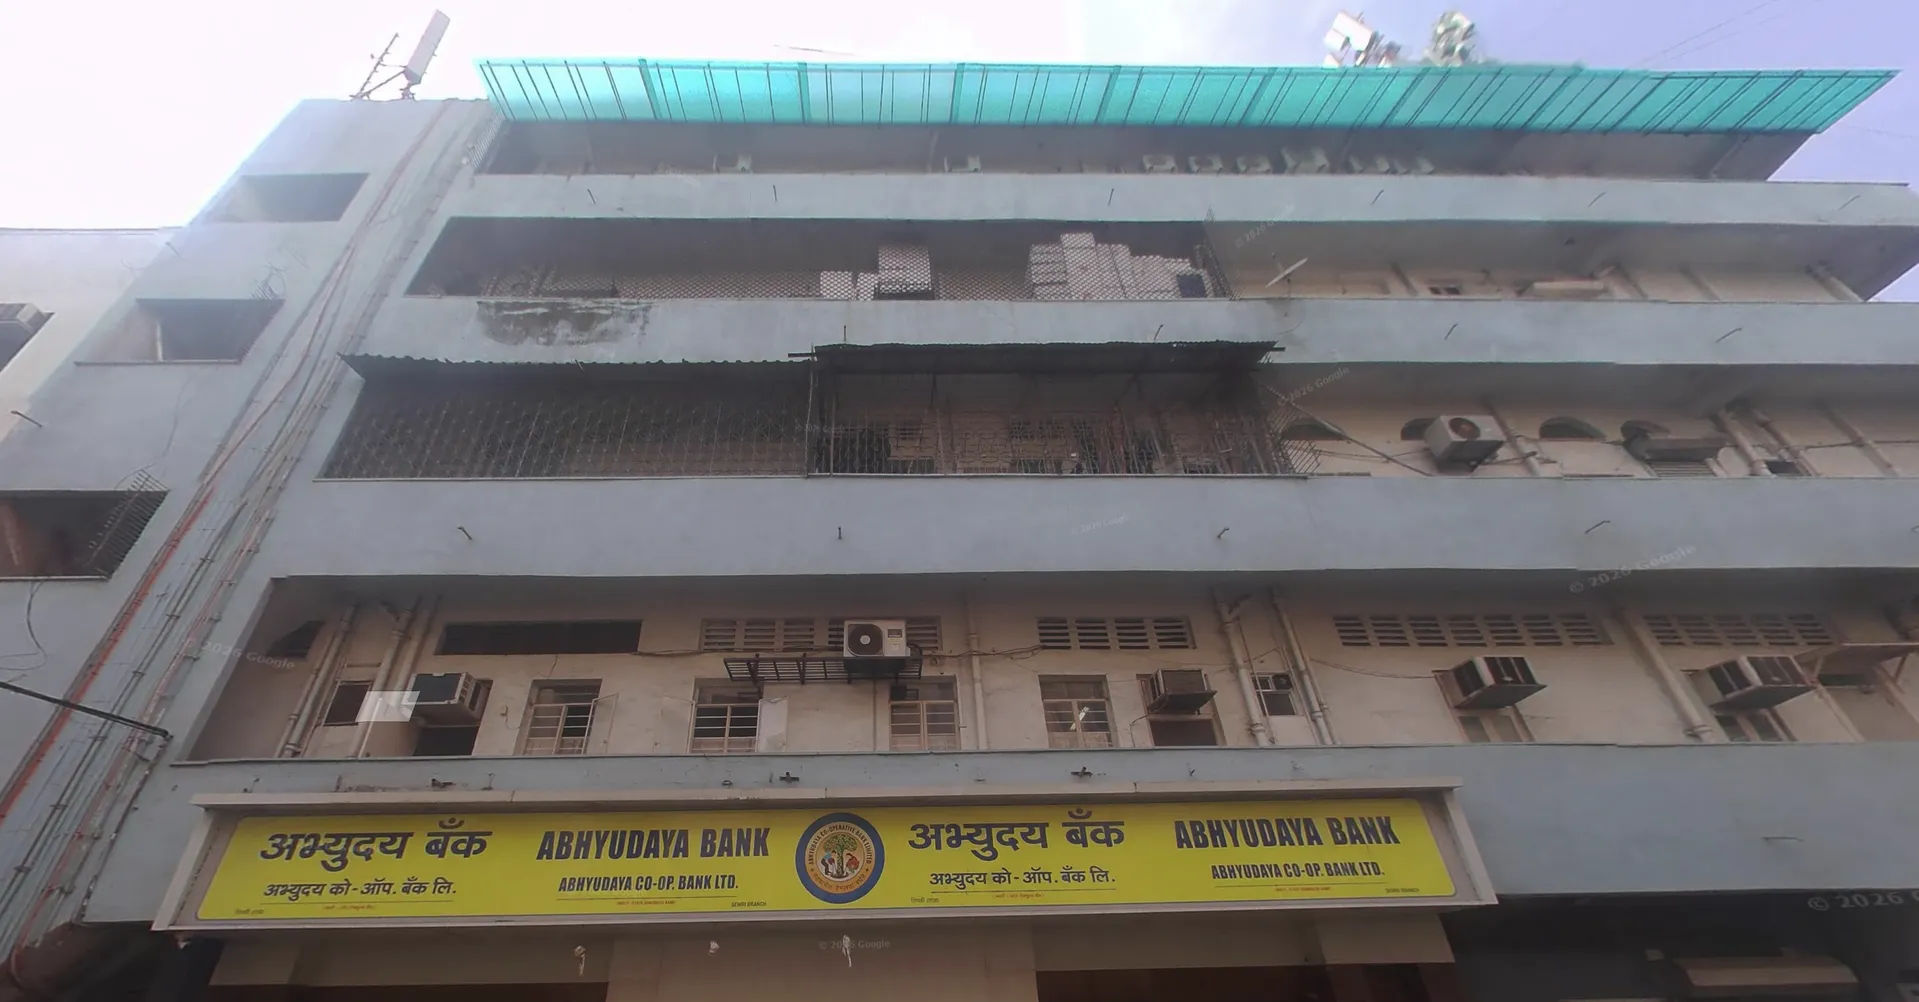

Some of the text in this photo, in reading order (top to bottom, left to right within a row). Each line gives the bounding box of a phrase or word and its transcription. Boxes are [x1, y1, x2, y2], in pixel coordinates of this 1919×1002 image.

[536, 827, 770, 860] ABHYUDAYA BANK
[908, 821, 1050, 862] अभ्युदय
[1174, 815, 1401, 849] ABHYUDAYA BANK
[260, 831, 415, 872] अभ्युदय
[558, 874, 739, 892] ABHYUDAYA CO-OP. BANK LTD.
[930, 872, 988, 891] अभ्युदय
[1089, 865, 1116, 883] लि.
[1211, 861, 1386, 880] ABHYUDAYA CO-OP. BANK LTD.
[263, 883, 328, 902] अभ्युदय
[431, 876, 457, 895] लि.
